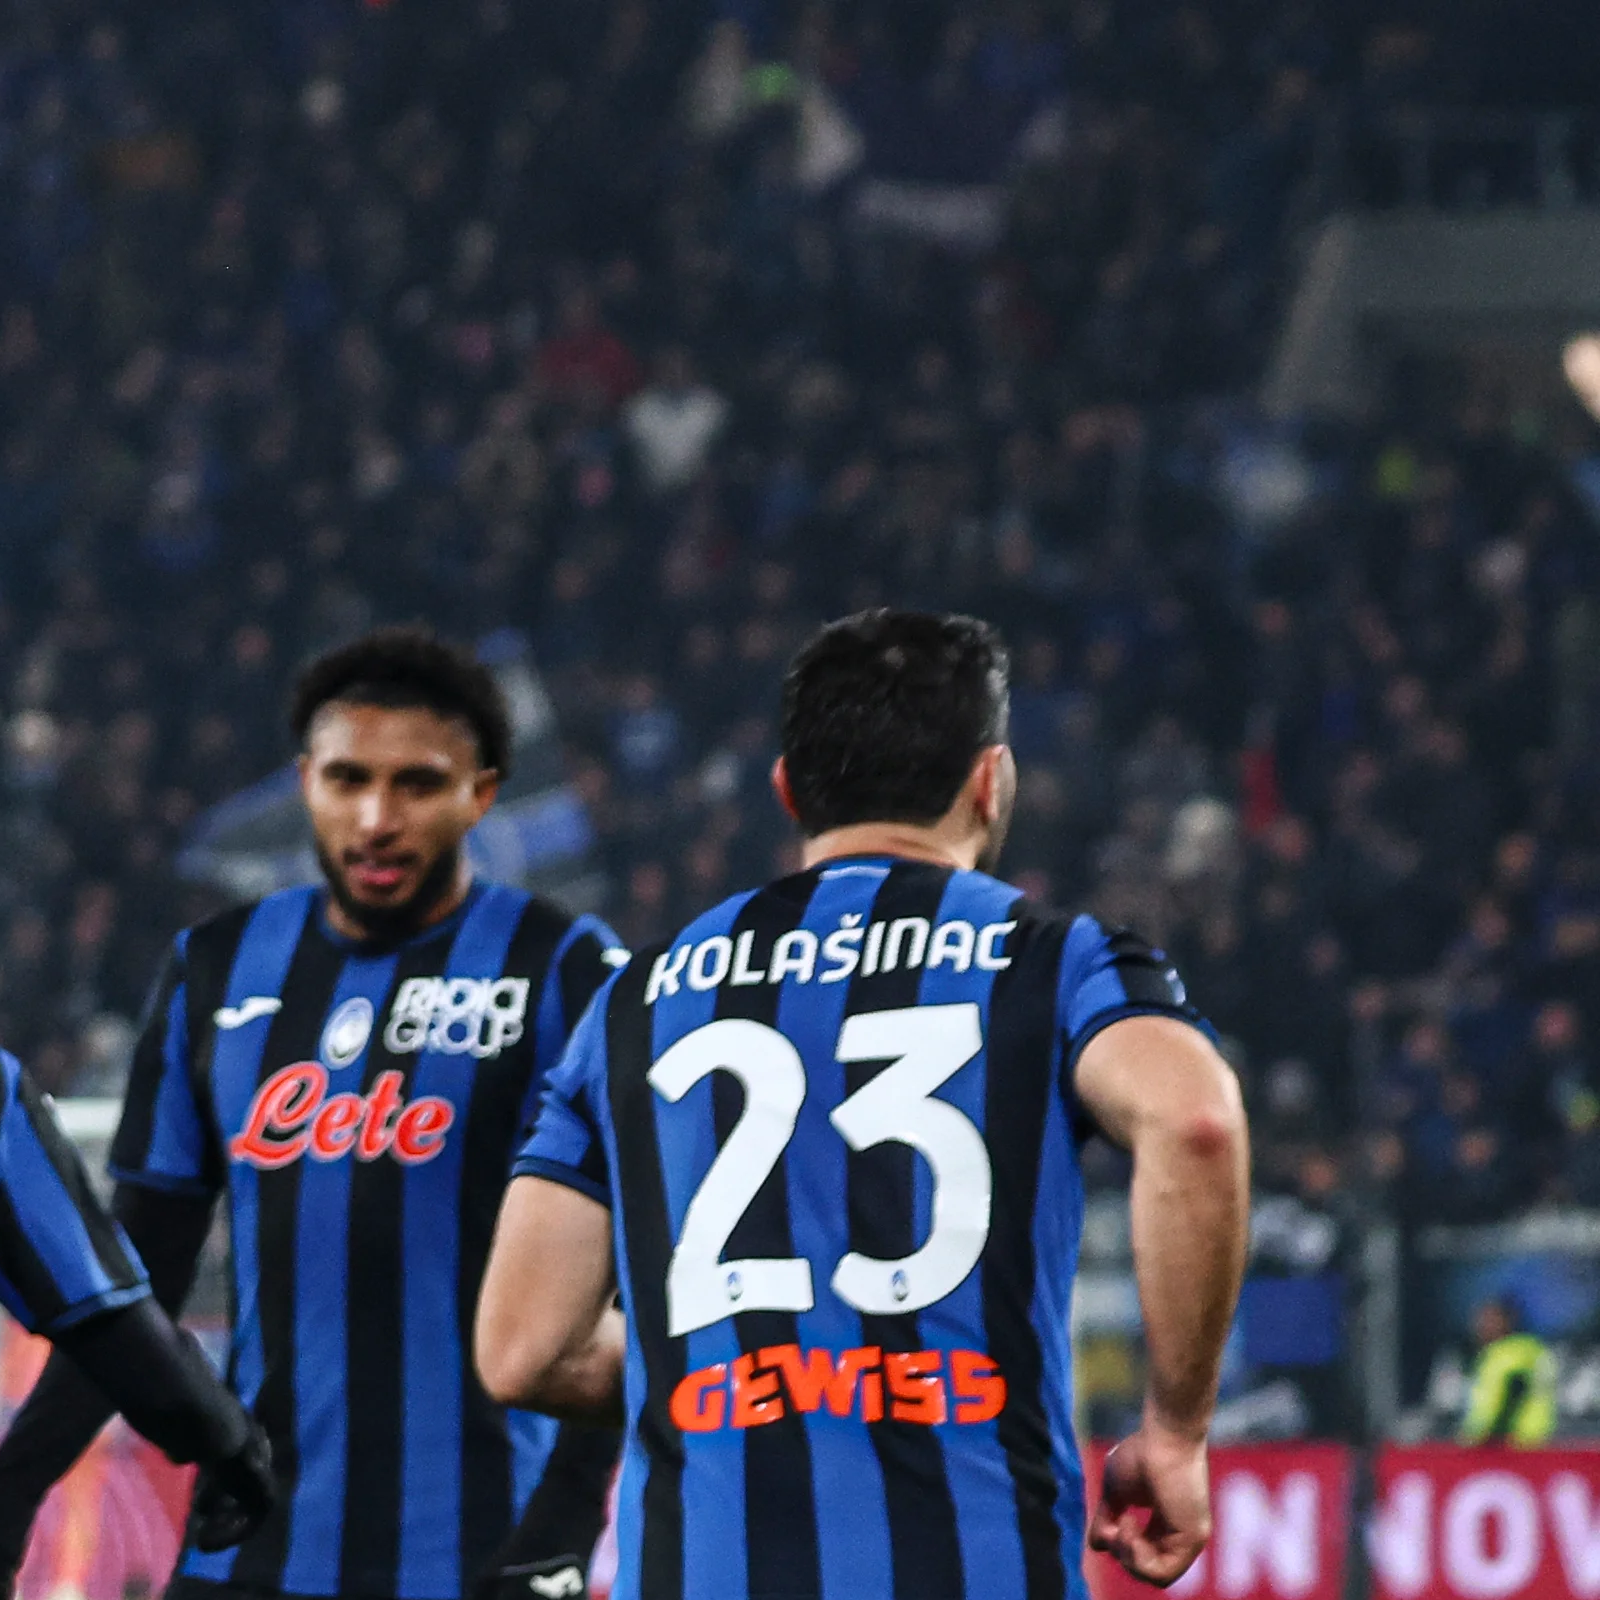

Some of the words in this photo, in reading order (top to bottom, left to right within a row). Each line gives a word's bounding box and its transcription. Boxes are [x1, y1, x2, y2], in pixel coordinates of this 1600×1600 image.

[644, 914, 1018, 1005] KOLAŠINAC
[230, 1061, 455, 1170] Lete
[646, 1003, 992, 1338] 23
